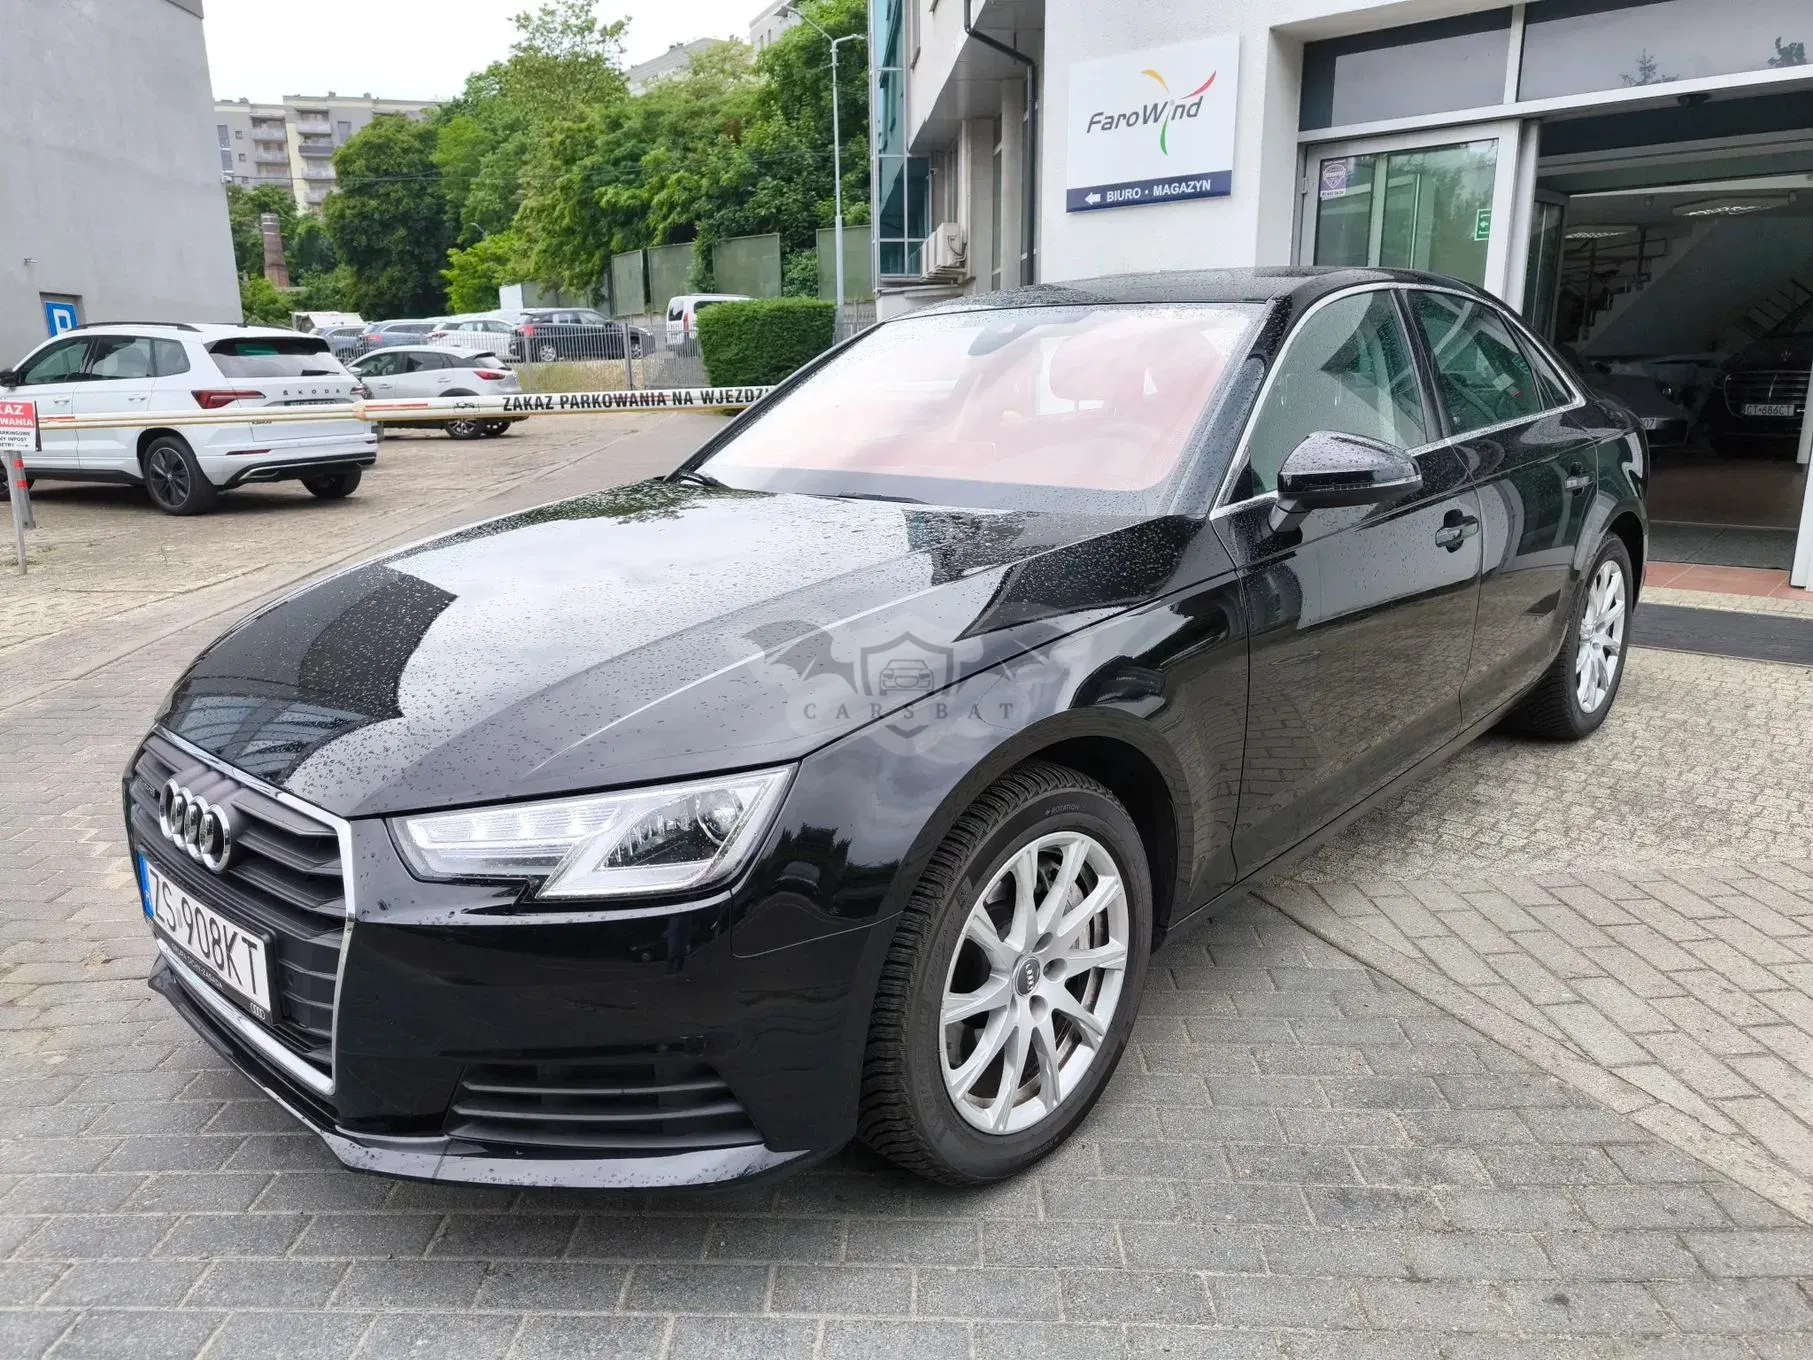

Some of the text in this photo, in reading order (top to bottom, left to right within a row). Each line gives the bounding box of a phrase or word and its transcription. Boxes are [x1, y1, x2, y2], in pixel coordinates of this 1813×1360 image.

[1086, 95, 1204, 134] FaroWind
[1106, 179, 1211, 202] BIURO MAGAZYN
[503, 387, 768, 412] ZAKAZ PARKOWANIA NA WJEZDZ
[149, 867, 258, 995] ZS 908KT
